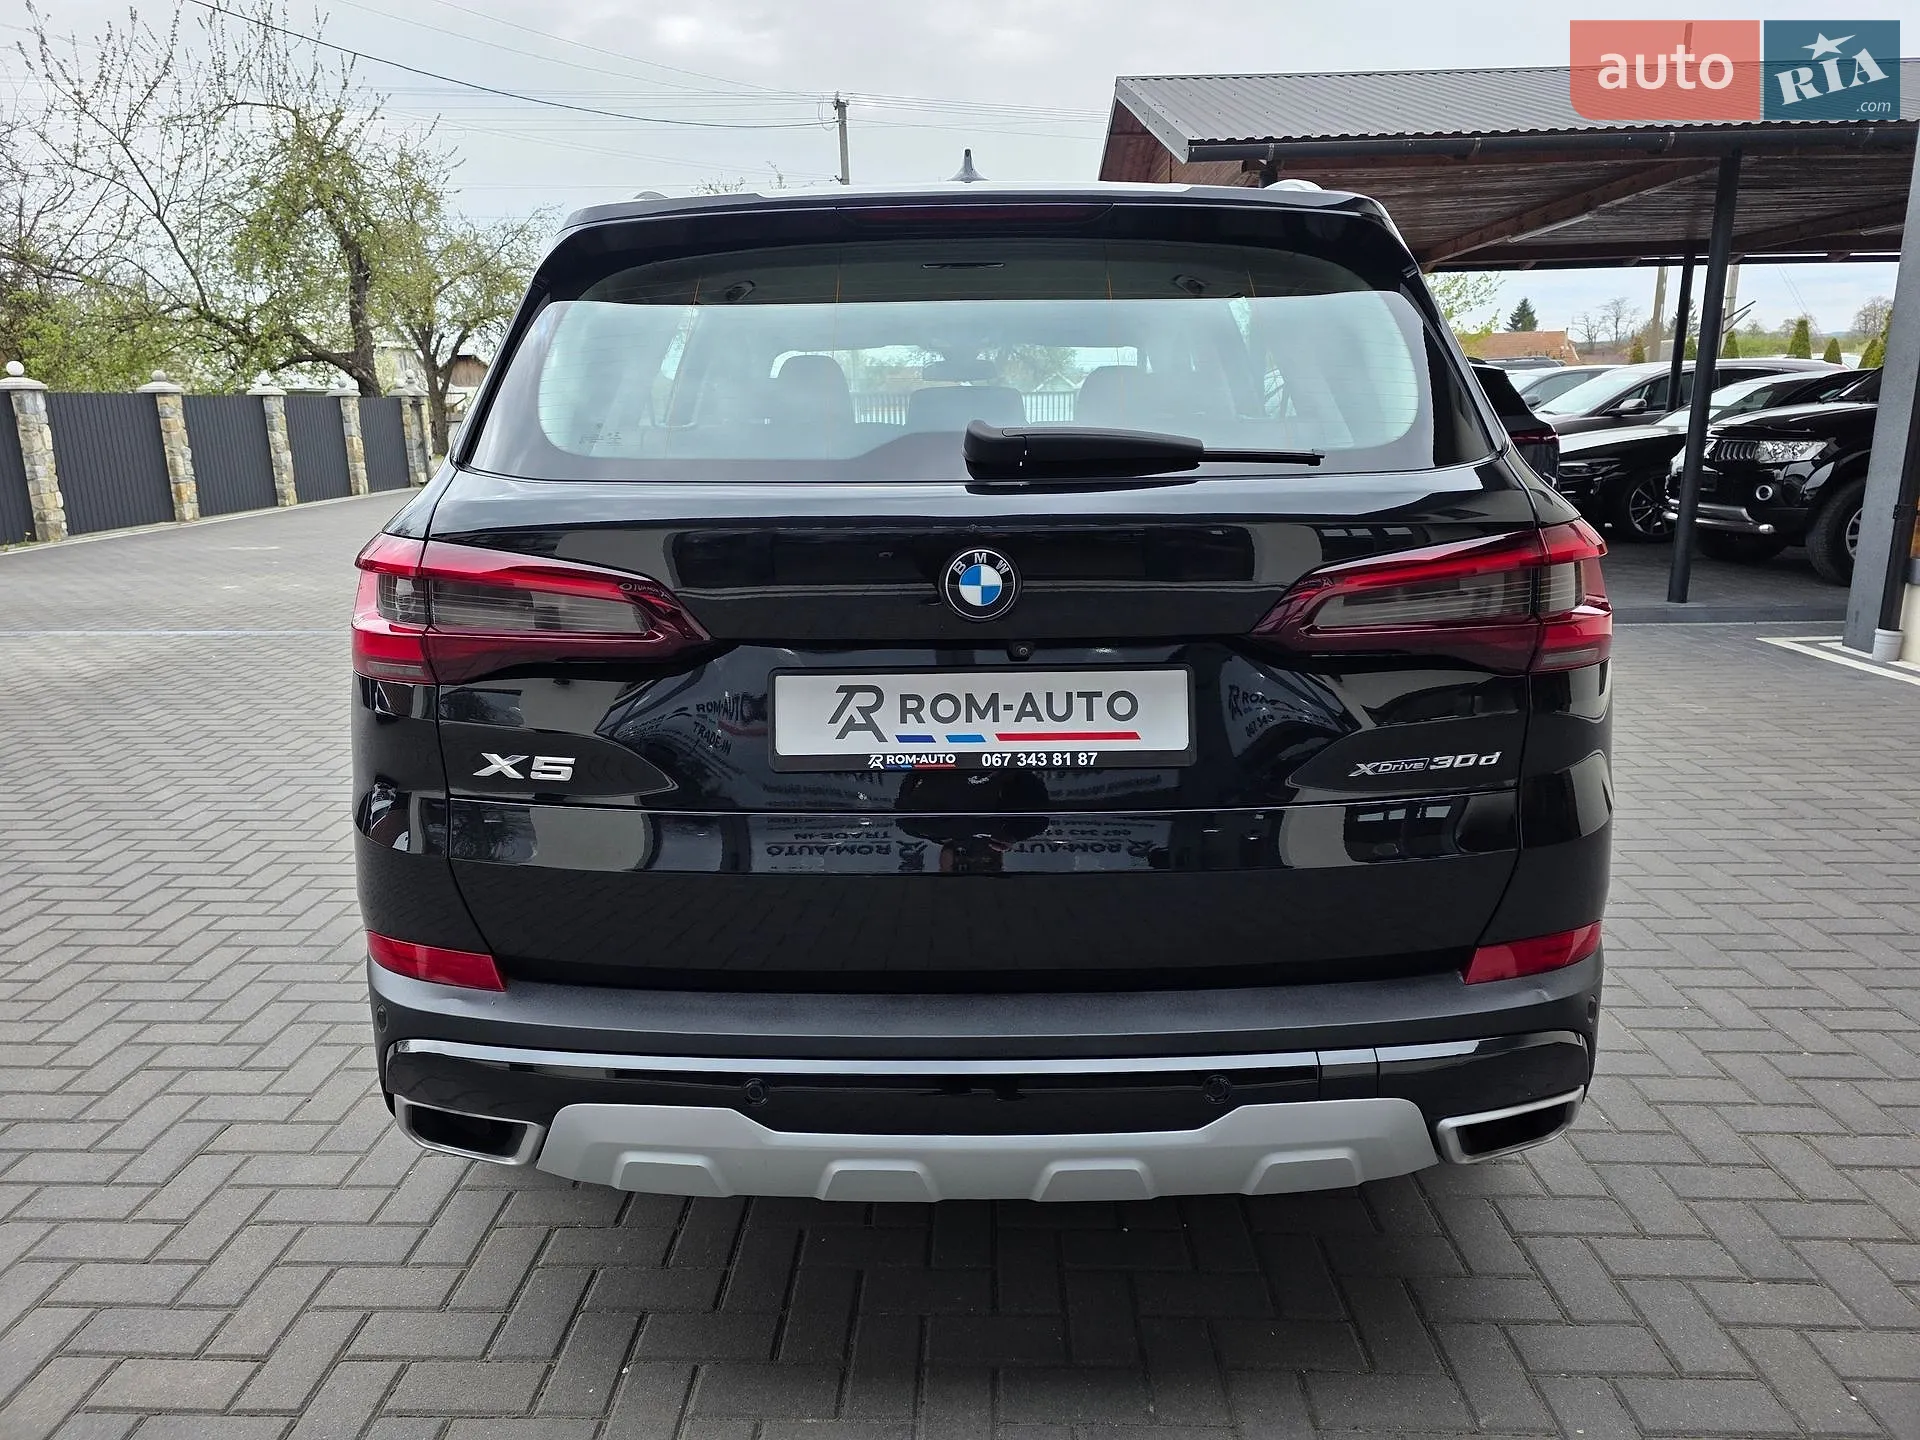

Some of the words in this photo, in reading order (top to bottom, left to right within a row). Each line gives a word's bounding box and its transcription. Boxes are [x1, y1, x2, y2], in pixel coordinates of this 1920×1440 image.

[952, 552, 1010, 575] BMW
[899, 690, 1139, 725] ROM-AUTO
[472, 752, 576, 782] X5
[886, 754, 957, 765] ROM-AUTO
[981, 753, 1014, 767] 067
[1016, 753, 1048, 767] 343
[1052, 752, 1071, 766] 81
[1077, 752, 1098, 766] 87
